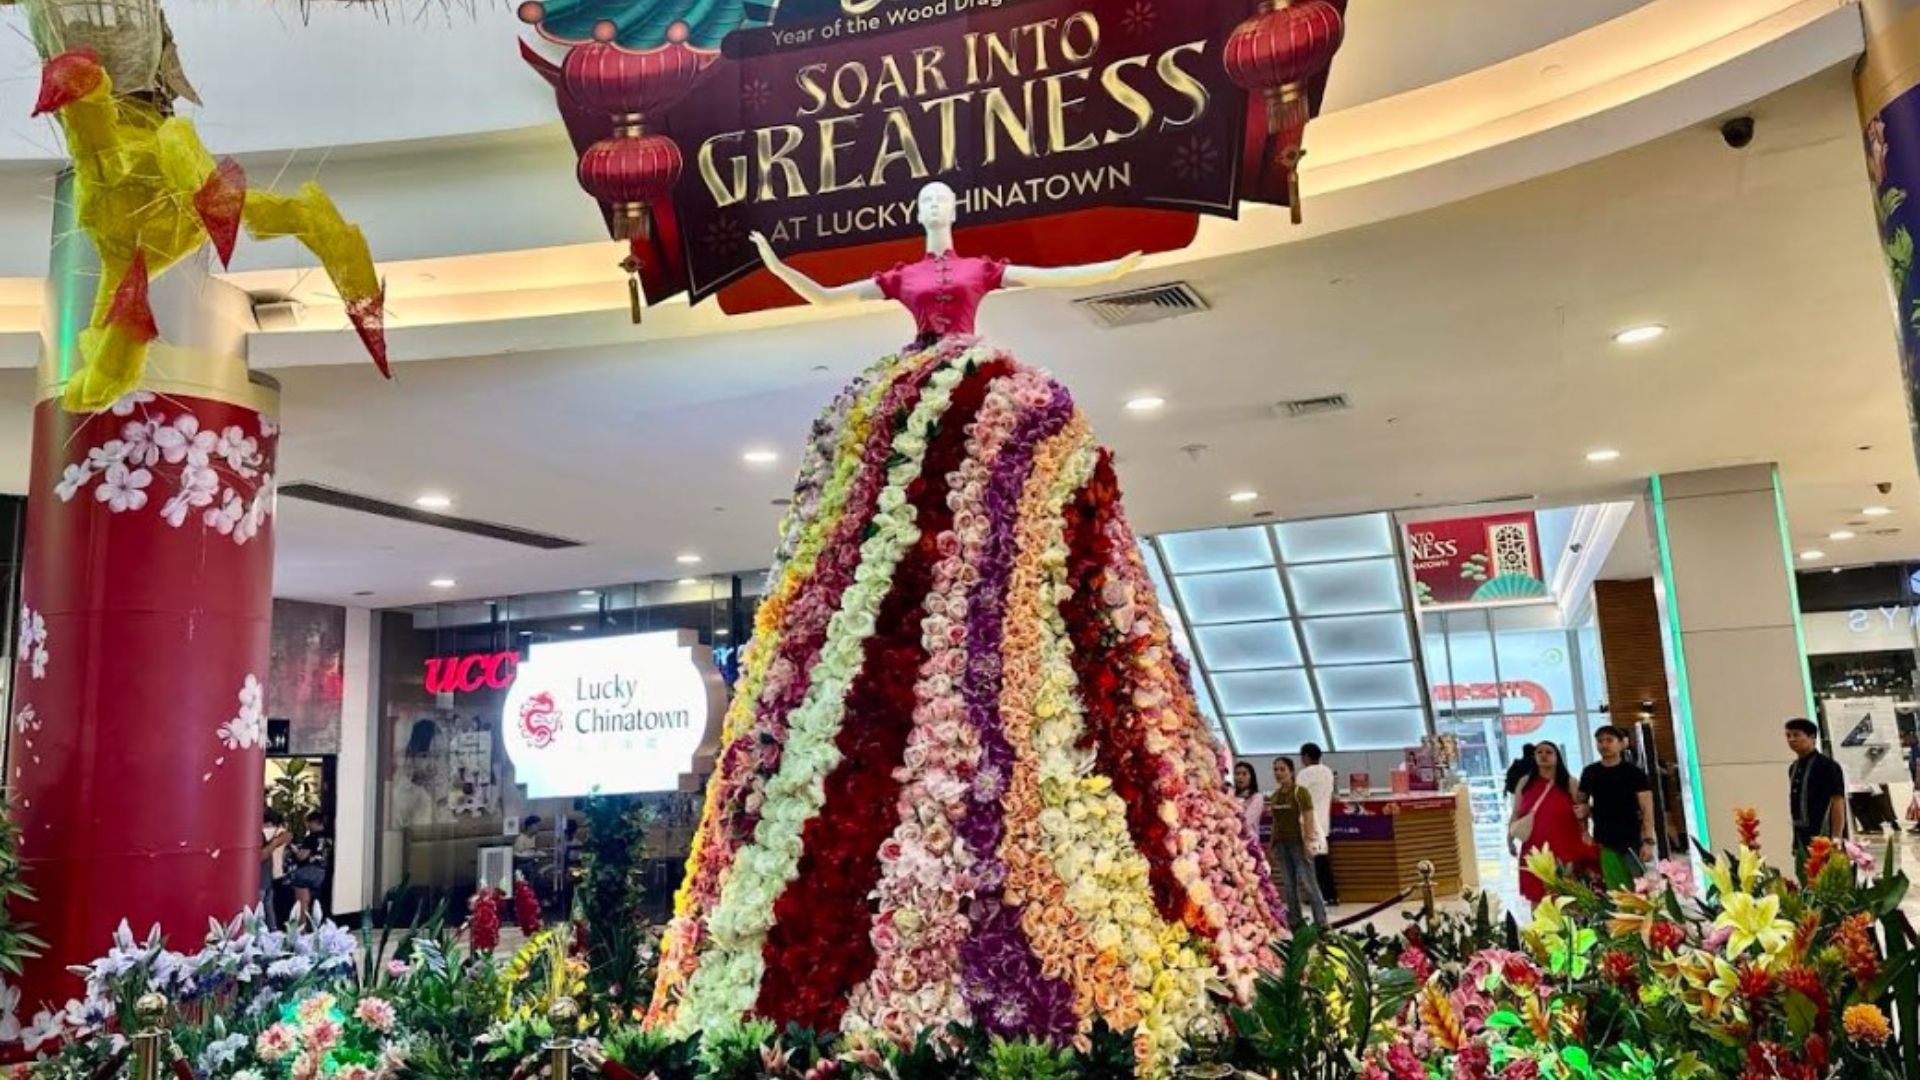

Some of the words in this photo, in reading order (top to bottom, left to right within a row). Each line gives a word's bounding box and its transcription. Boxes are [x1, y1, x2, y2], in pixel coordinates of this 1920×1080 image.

[772, 29, 813, 46] Year
[821, 18, 842, 38] of
[847, 15, 881, 33] the
[886, 0, 947, 26] Wood
[796, 46, 948, 118] SOAR
[963, 11, 1100, 85] INTO
[698, 39, 1211, 207] GREATNESS
[771, 216, 808, 242] AT
[817, 200, 918, 236] LUCKY
[953, 161, 1131, 214] HINATOWN
[575, 707, 689, 734] Chinatown
[577, 674, 638, 708] Lucky
